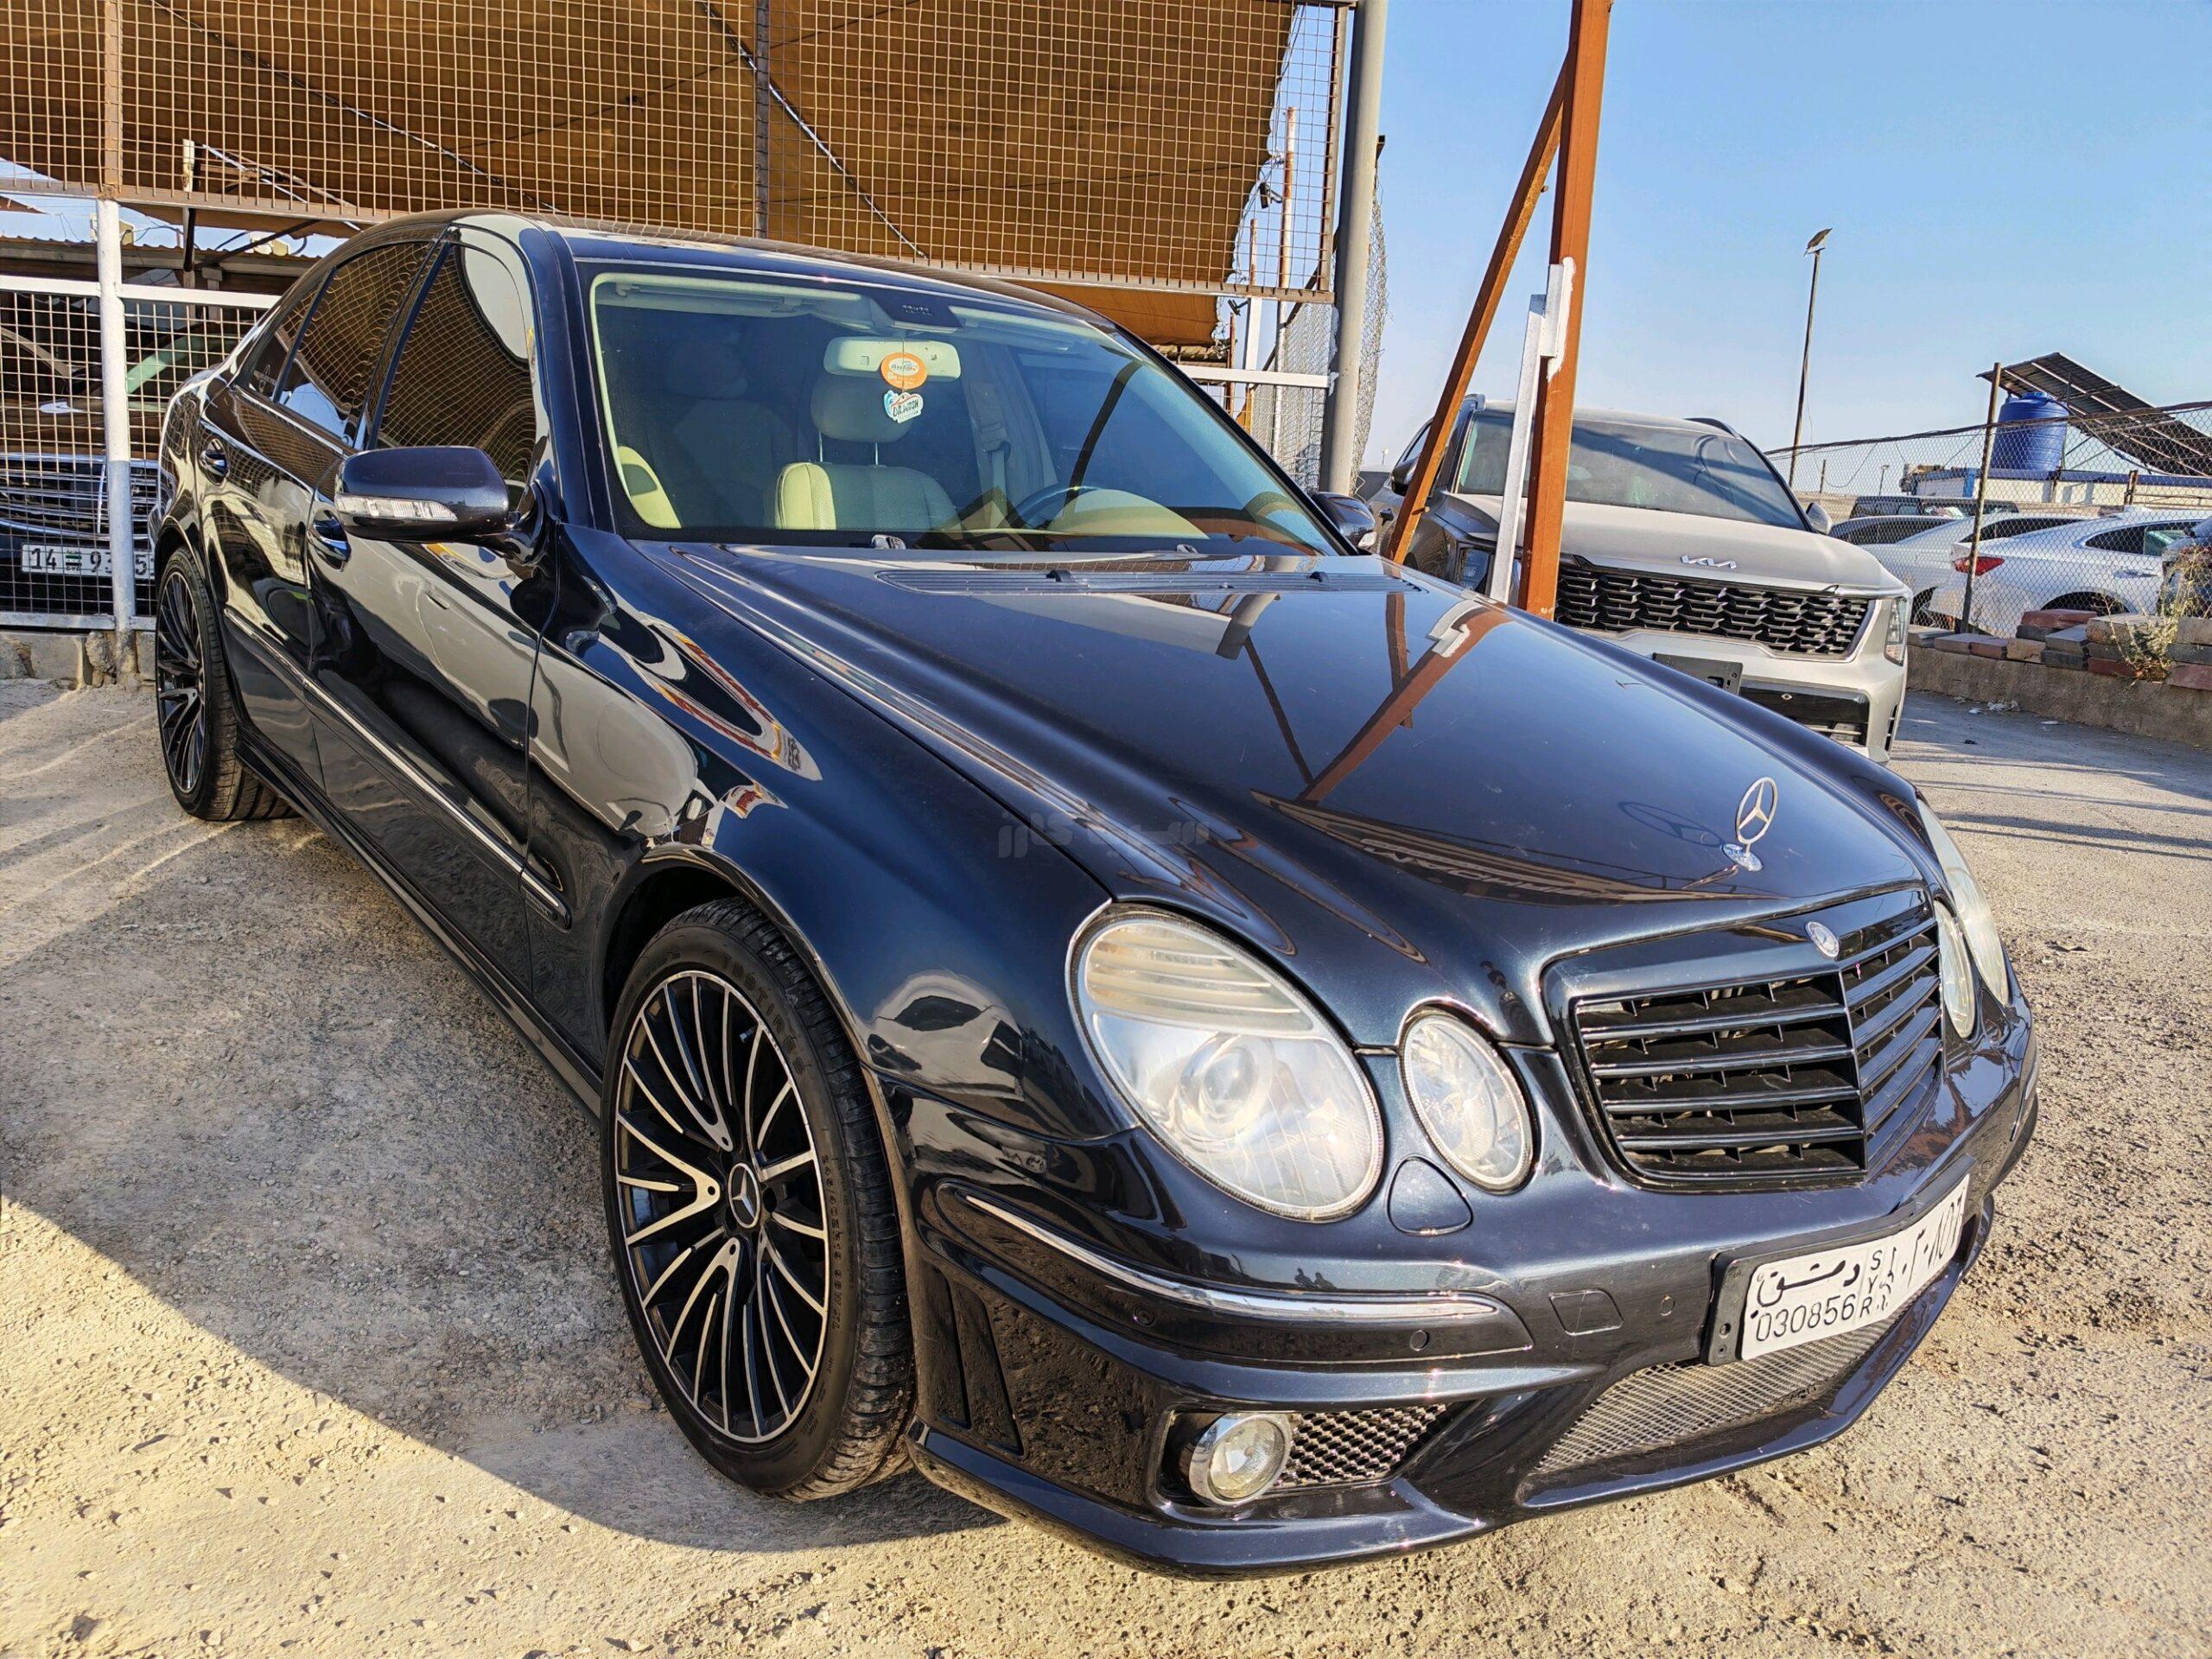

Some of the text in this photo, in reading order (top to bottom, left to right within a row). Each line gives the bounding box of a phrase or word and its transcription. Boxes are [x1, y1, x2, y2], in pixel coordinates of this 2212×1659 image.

[31, 548, 57, 570] 14
[1758, 1260, 1860, 1307] دمشق
[1757, 1294, 1856, 1342] 030856
